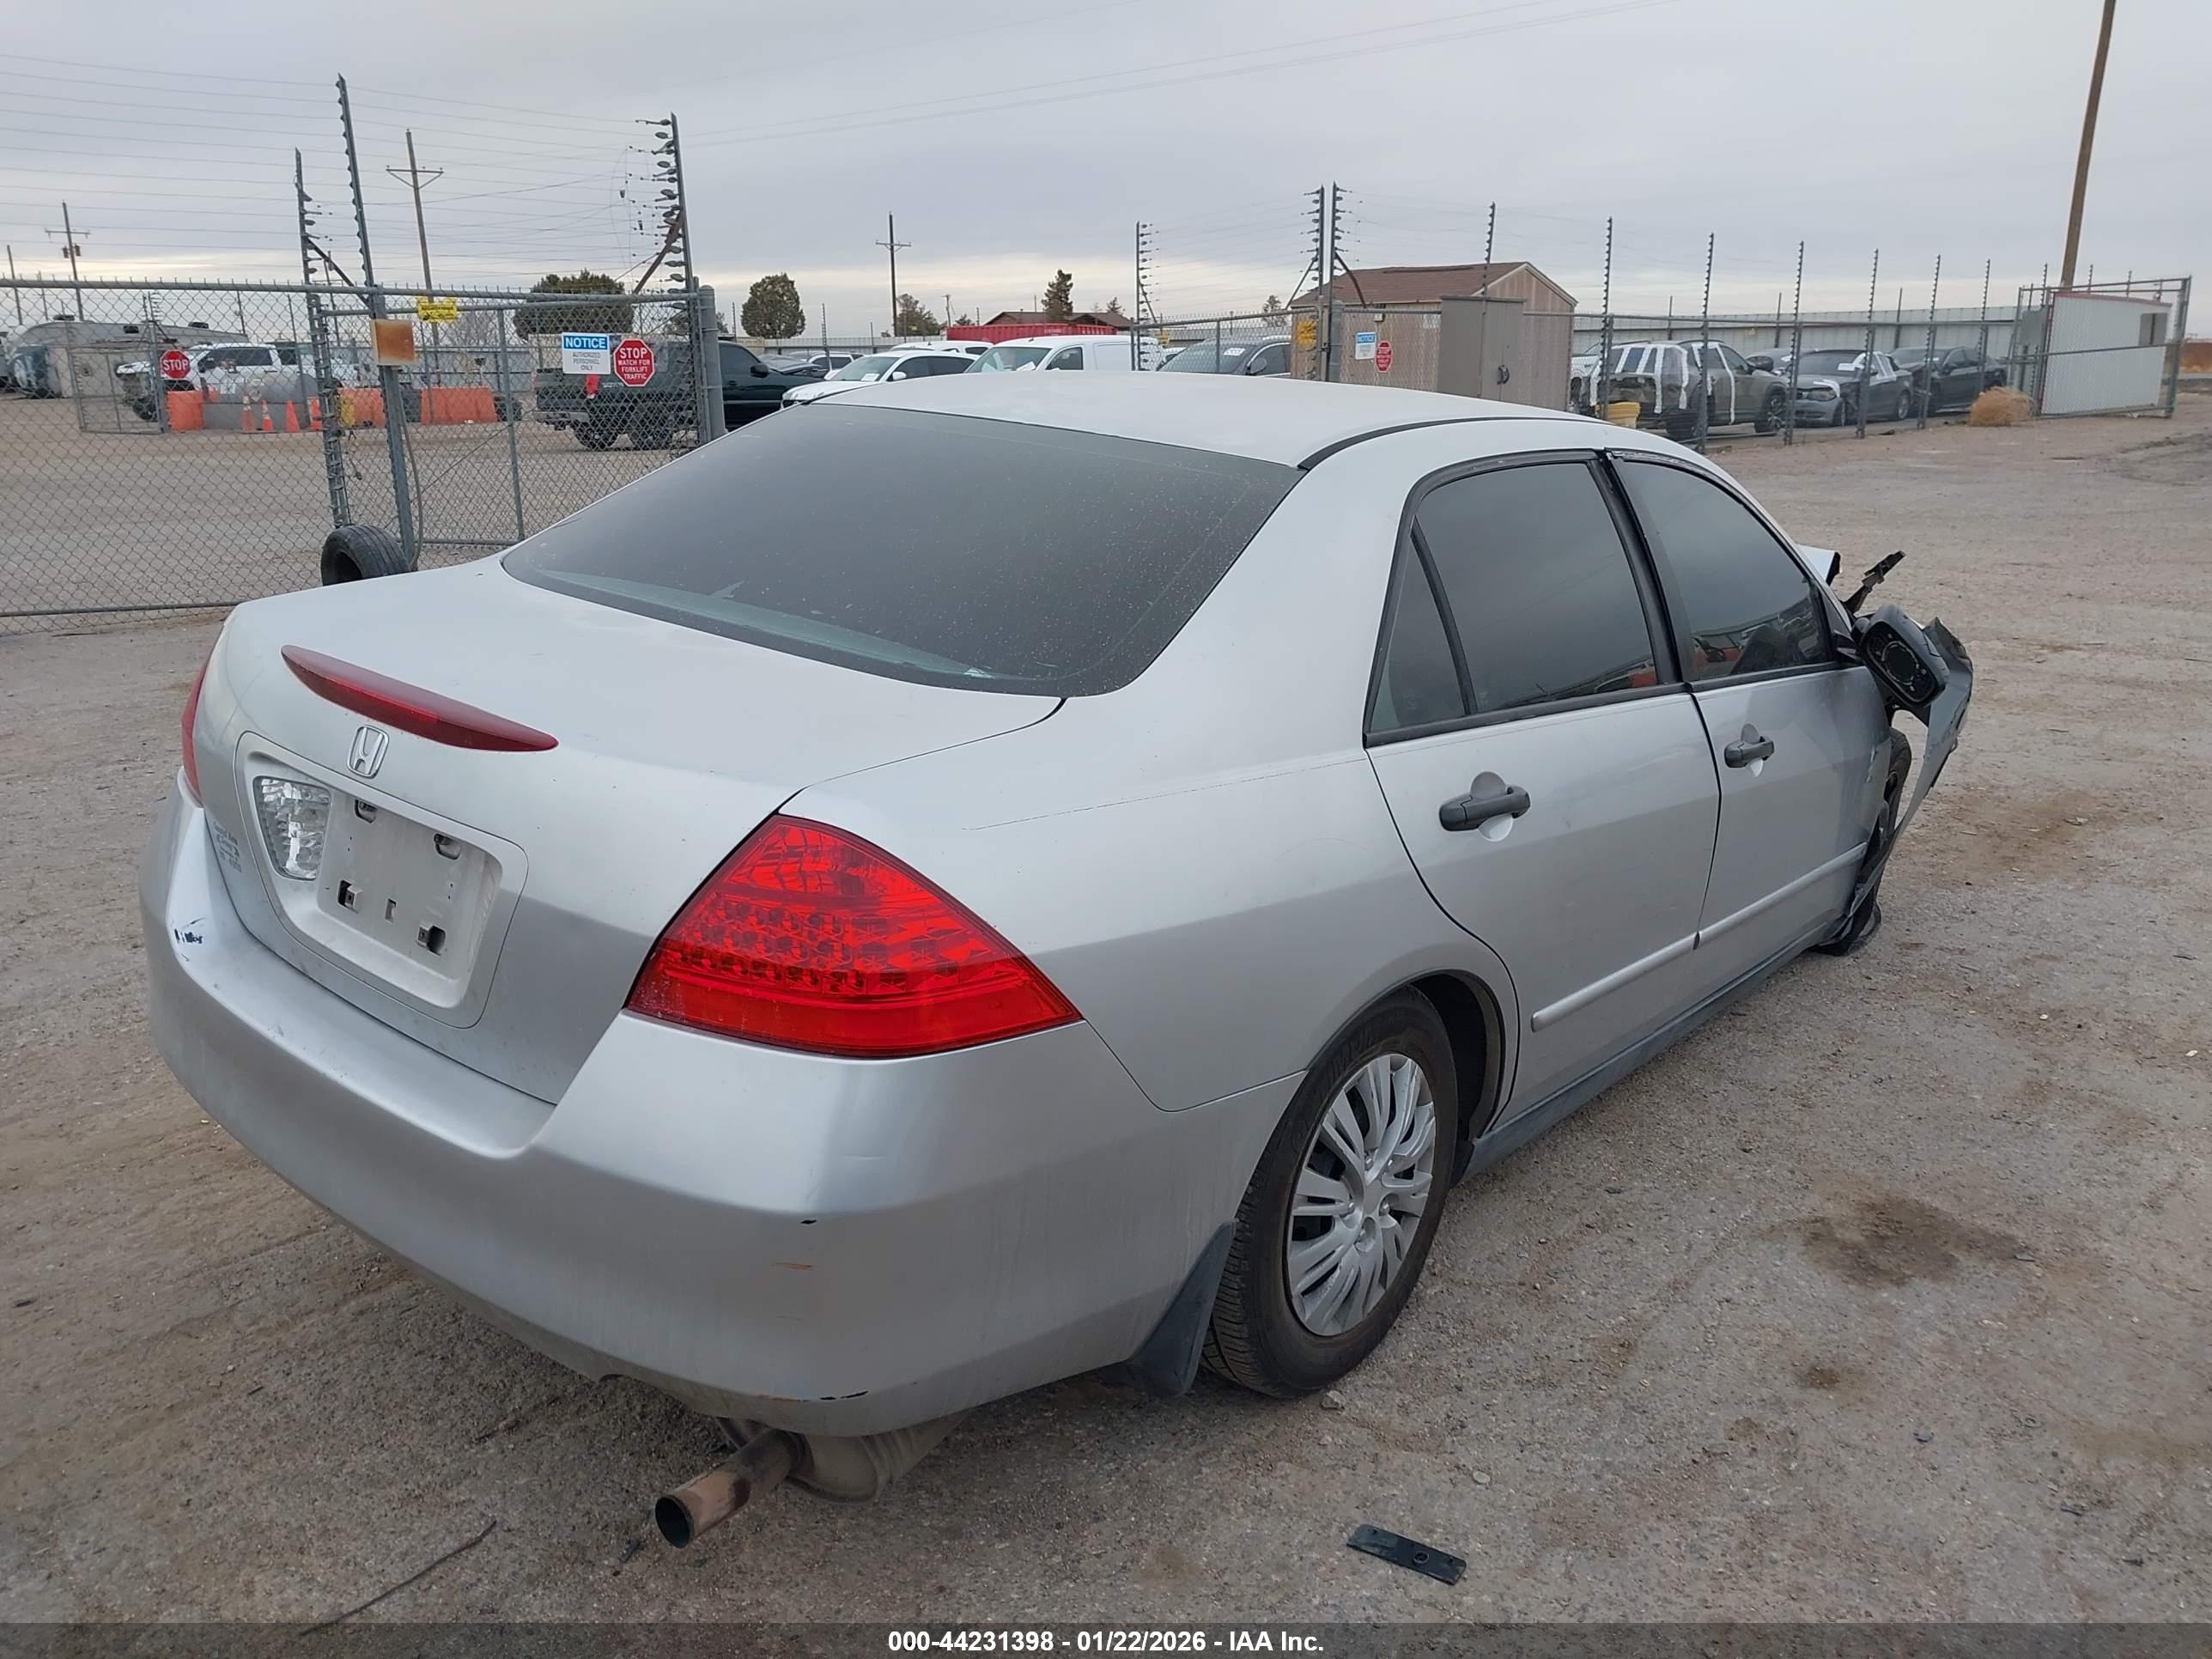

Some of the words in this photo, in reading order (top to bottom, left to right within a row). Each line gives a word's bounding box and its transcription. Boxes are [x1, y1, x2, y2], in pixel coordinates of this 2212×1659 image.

[565, 337, 606, 348] NOTICE
[619, 347, 647, 359] STOP
[163, 359, 188, 371] STOP
